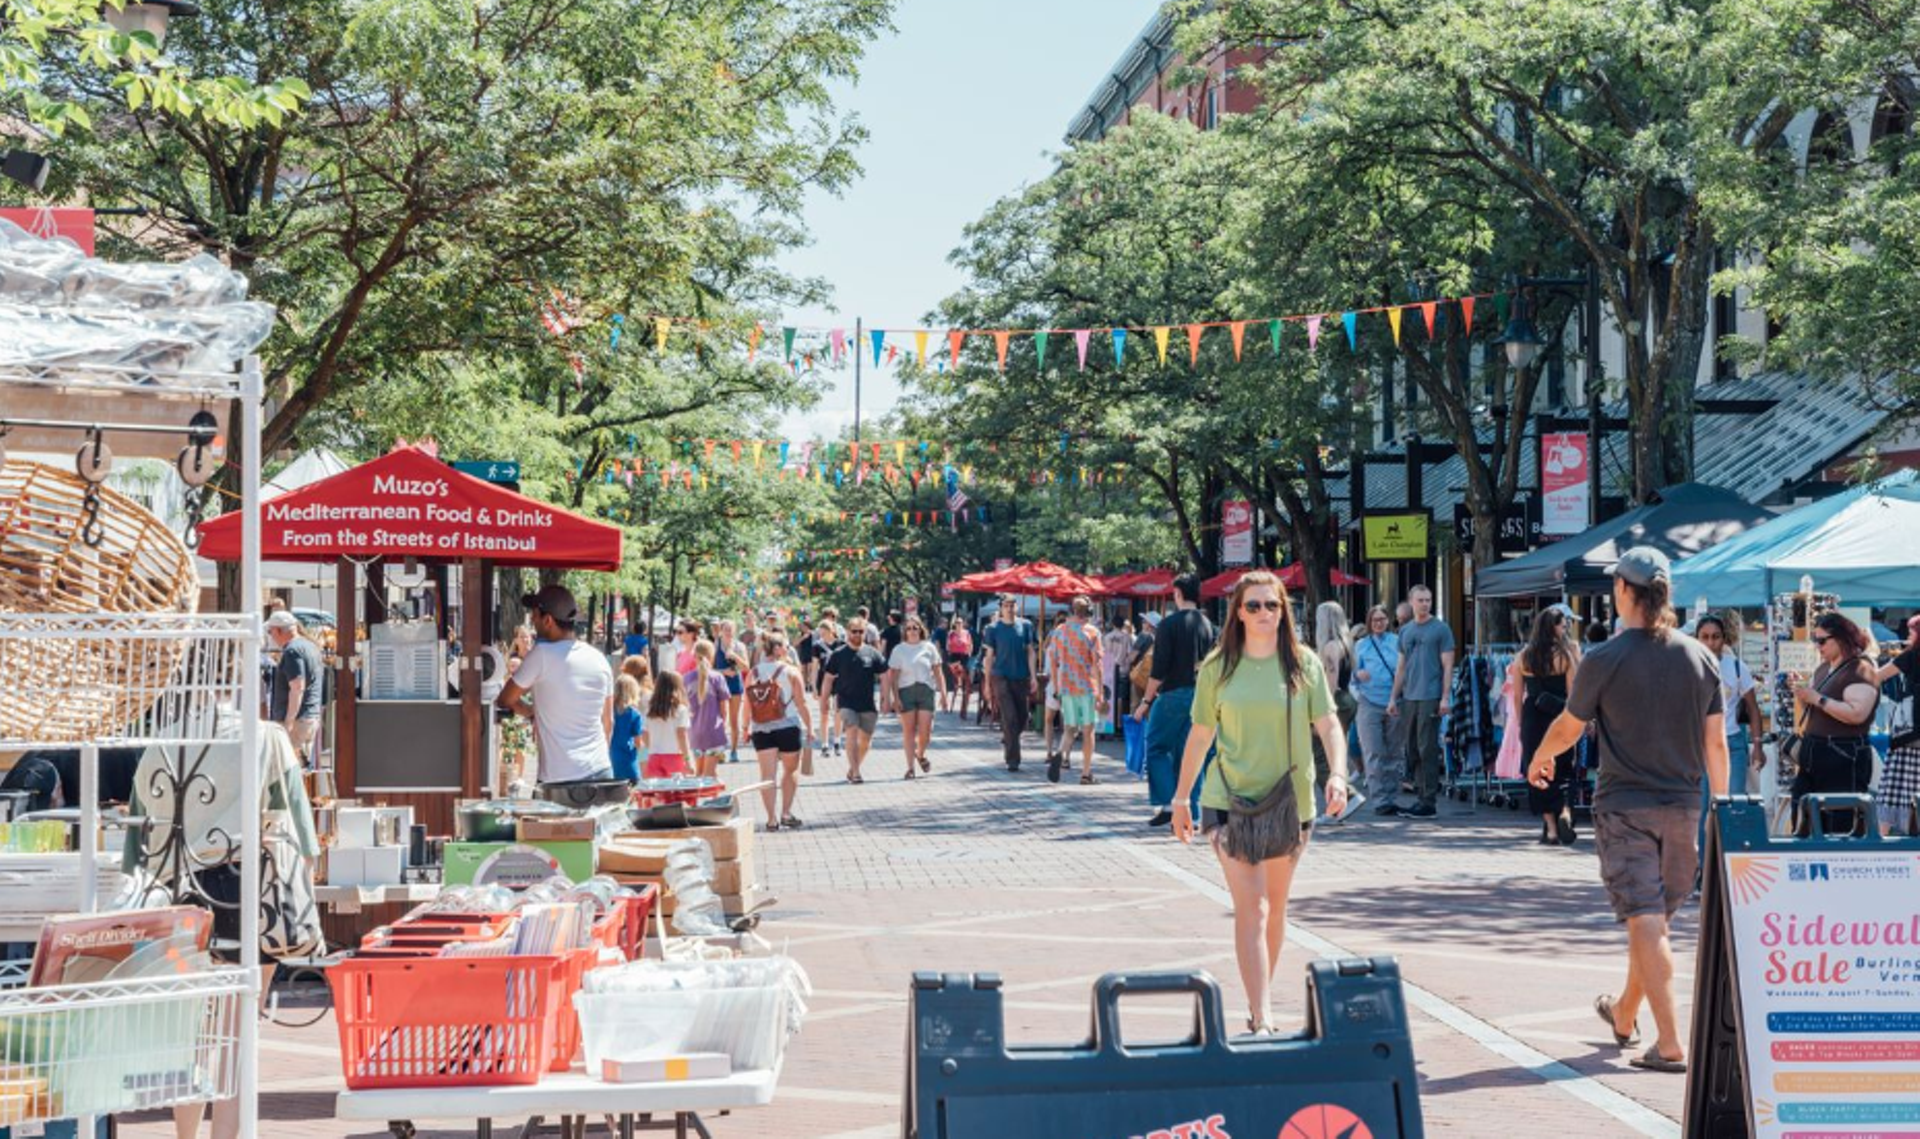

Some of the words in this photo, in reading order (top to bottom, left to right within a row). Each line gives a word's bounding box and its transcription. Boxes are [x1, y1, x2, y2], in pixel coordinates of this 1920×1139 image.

[373, 475, 449, 497] Muzo's
[267, 503, 420, 521] Mediterranean
[426, 503, 472, 523] Food
[477, 507, 491, 525] &
[497, 508, 553, 527] Drinks
[282, 529, 332, 547] From
[337, 529, 368, 546] the
[372, 528, 434, 547] Streets
[438, 530, 459, 548] of
[464, 533, 536, 551] Istanbul
[60, 931, 96, 948] Shelf
[1760, 912, 1920, 947] Sidewal
[1764, 949, 1852, 985] Sale
[1855, 957, 1920, 970] Burling
[1880, 971, 1920, 981] Verm
